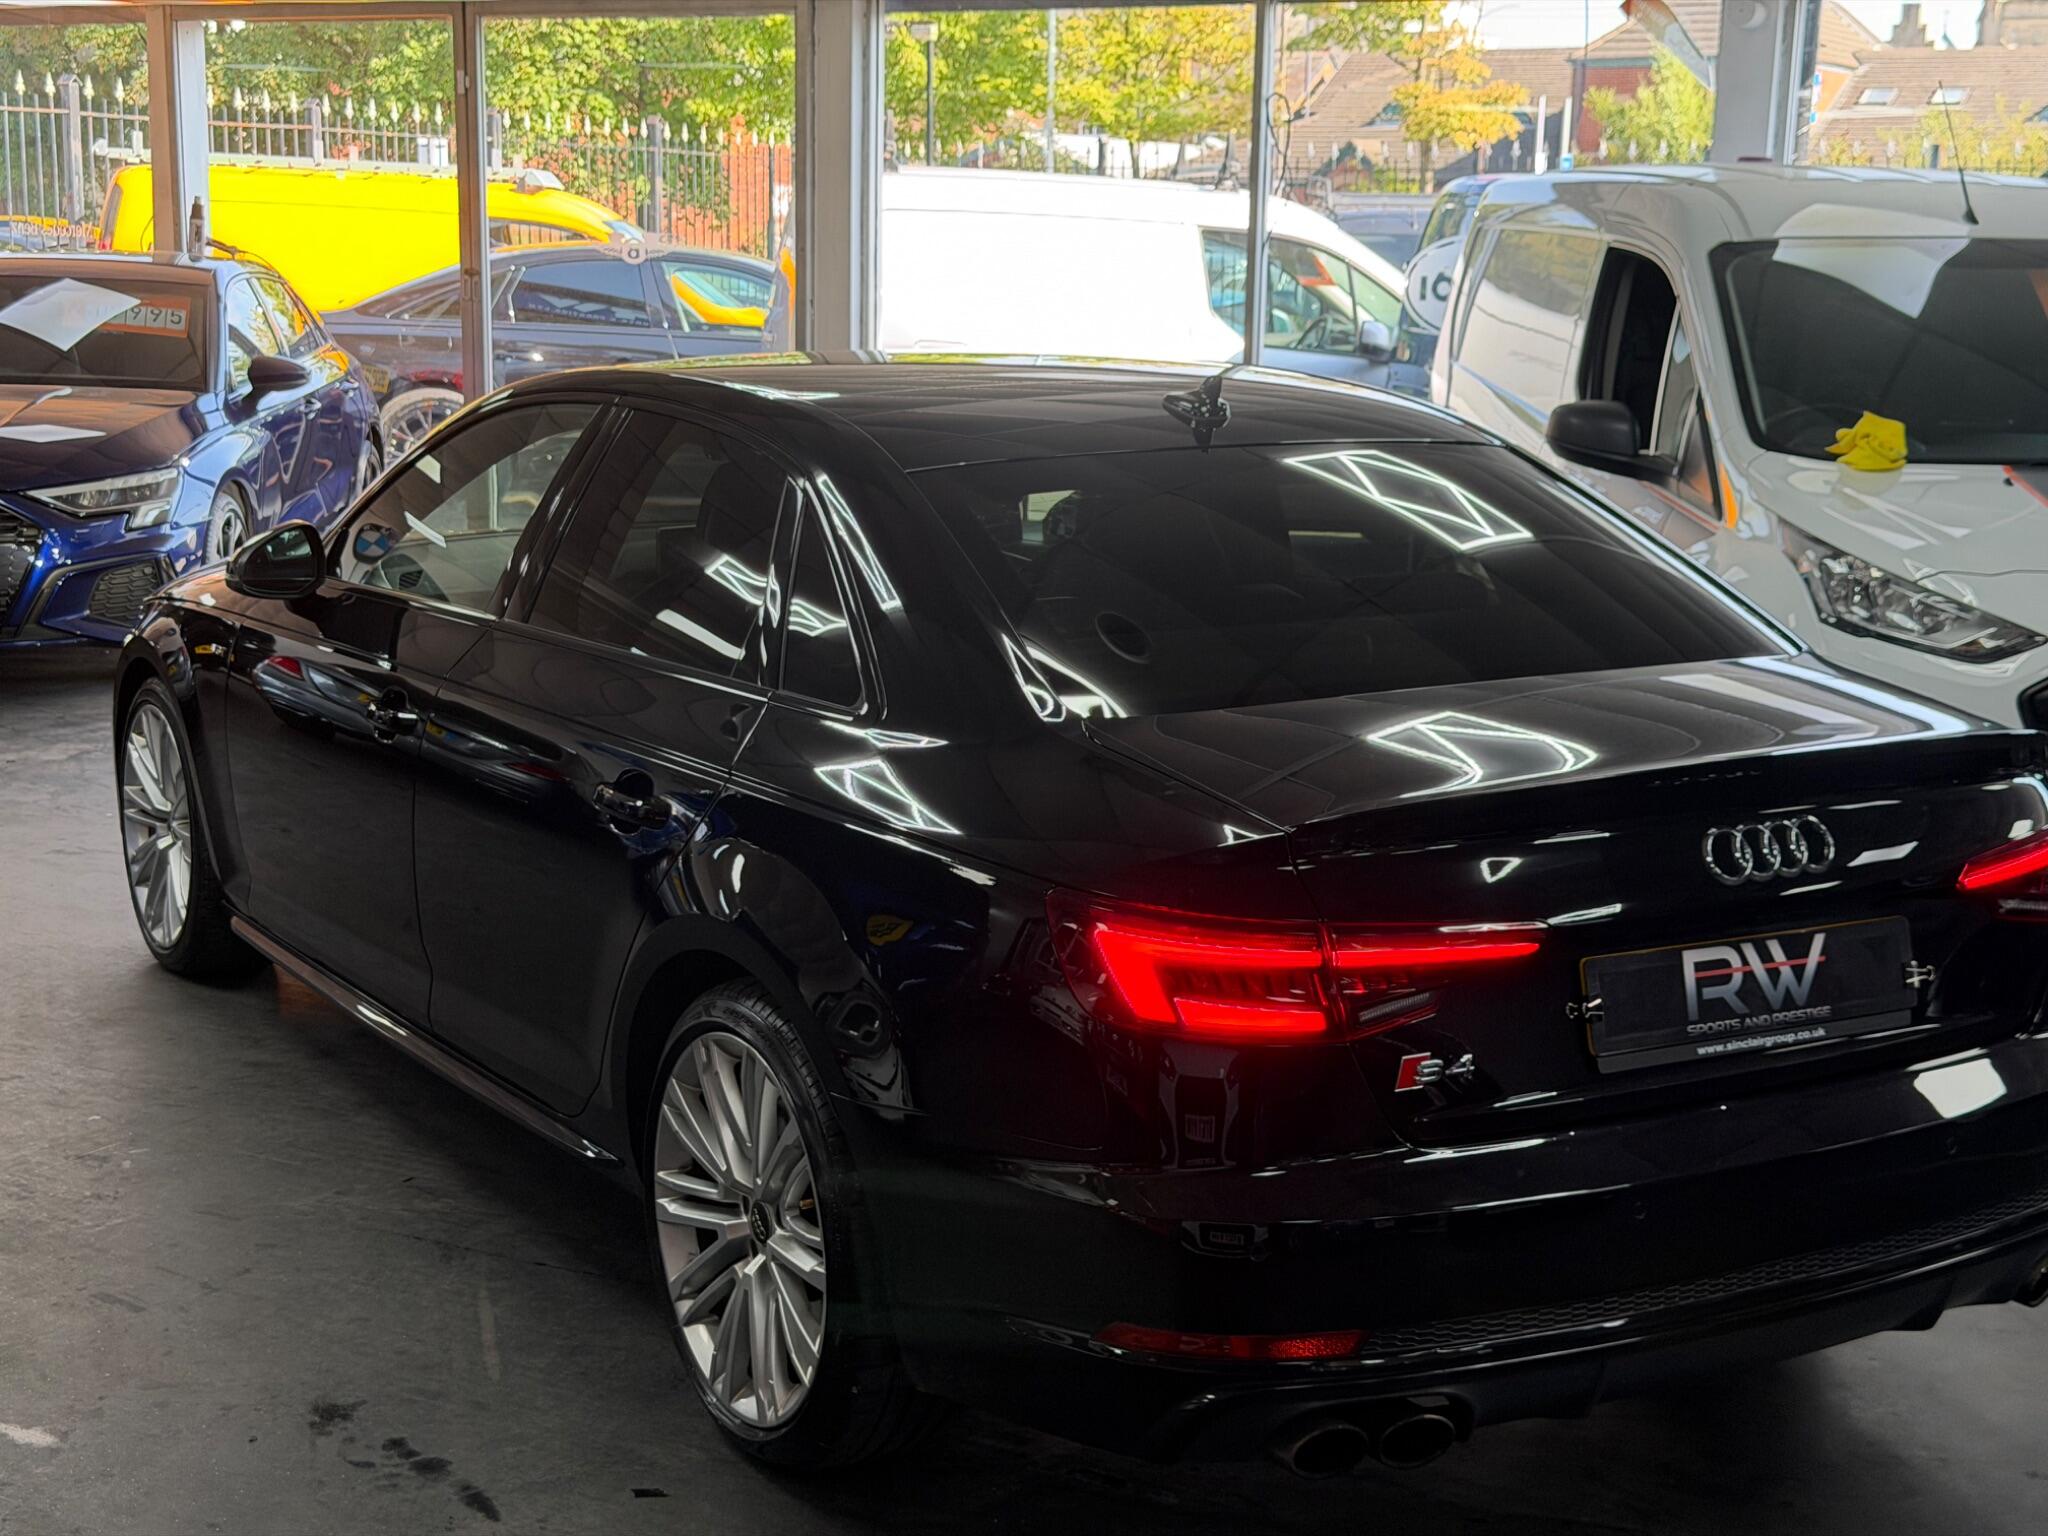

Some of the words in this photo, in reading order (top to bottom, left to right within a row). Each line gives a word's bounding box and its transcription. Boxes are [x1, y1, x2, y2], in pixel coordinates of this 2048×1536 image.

[130, 306, 184, 325] 995
[1681, 932, 1826, 1022] RW
[1686, 1018, 1742, 1037] SPORTS
[1744, 1013, 1771, 1029] AND
[1772, 1005, 1832, 1025] PRESTIGE
[1696, 1027, 1827, 1056] www.sinclairgroup.co.uk
[1412, 1053, 1475, 1086] S4
